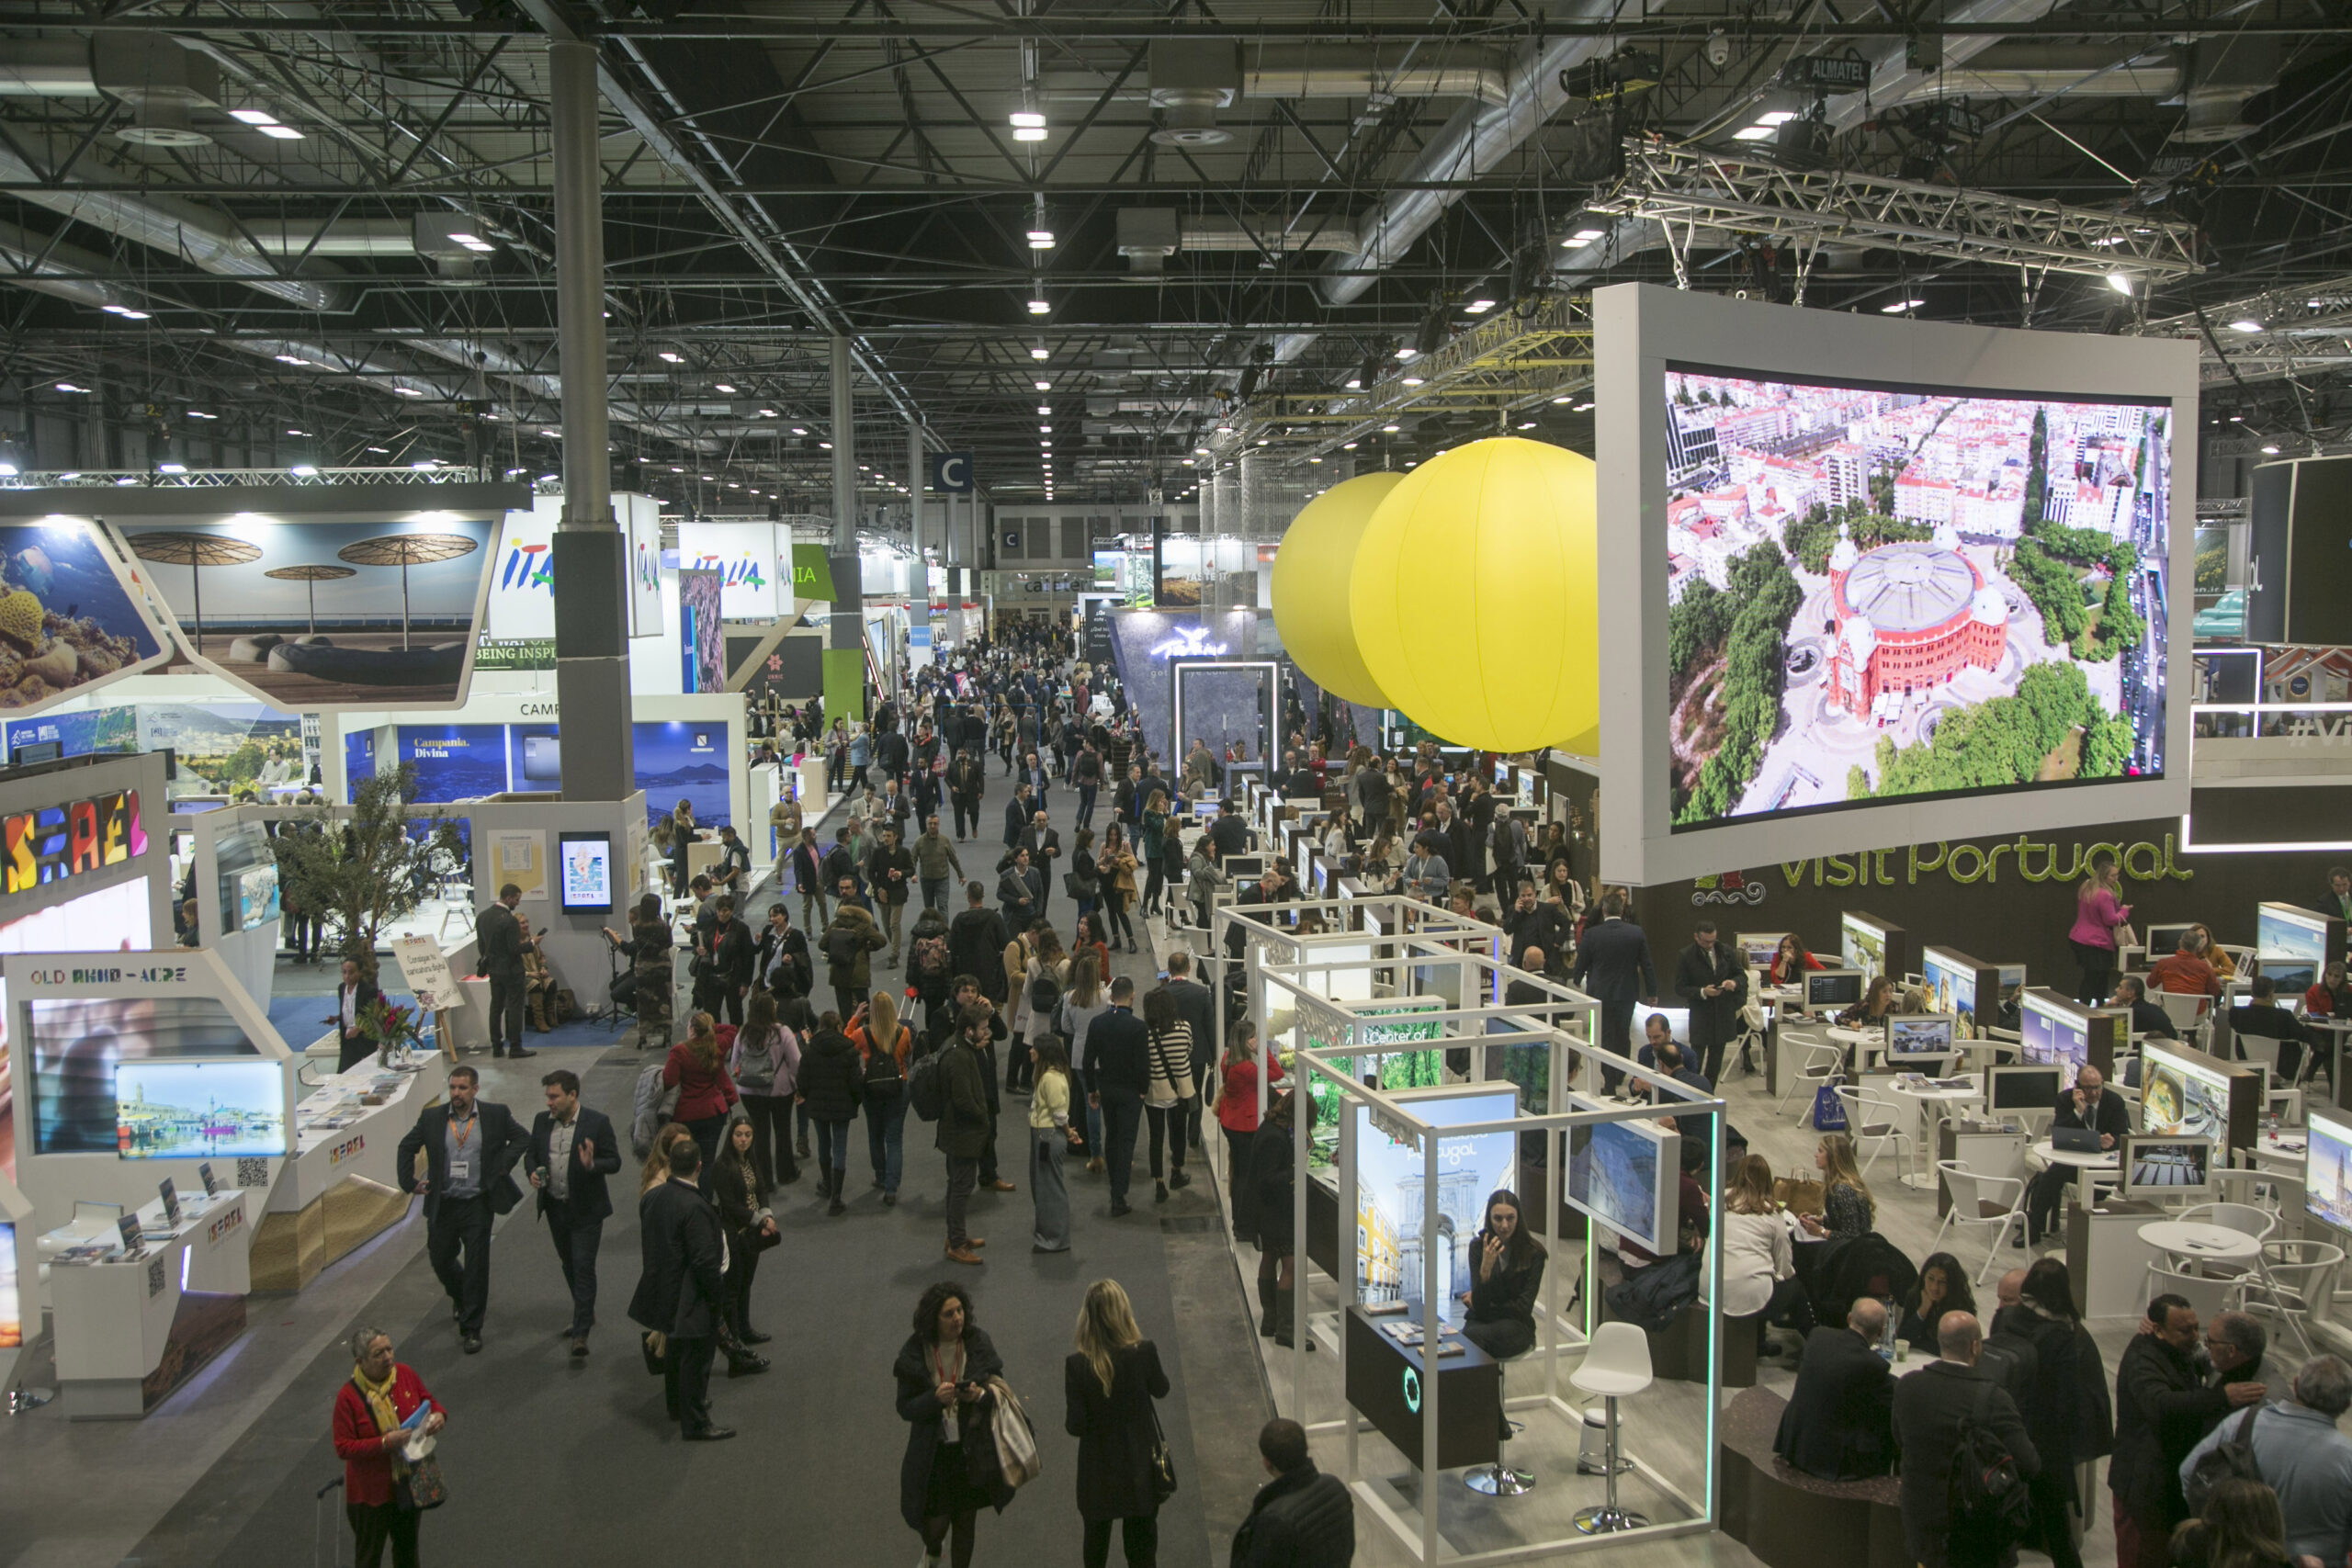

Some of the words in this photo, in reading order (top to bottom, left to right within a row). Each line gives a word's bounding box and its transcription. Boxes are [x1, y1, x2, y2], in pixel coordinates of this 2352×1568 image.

[1812, 59, 1865, 81] ALMATEL
[941, 458, 964, 487] C
[1006, 534, 1016, 546] C
[503, 537, 554, 597] ITA
[1185, 572, 1216, 581] TASTE
[415, 749, 448, 758] Divina
[0, 788, 149, 894] SRAEL
[31, 970, 65, 985] OLD
[140, 967, 187, 982] ACRE
[1370, 1031, 1410, 1044] Center
[1414, 1028, 1427, 1041] of
[330, 1134, 365, 1165] ISRAEL
[209, 1206, 242, 1245] ISRAEL
